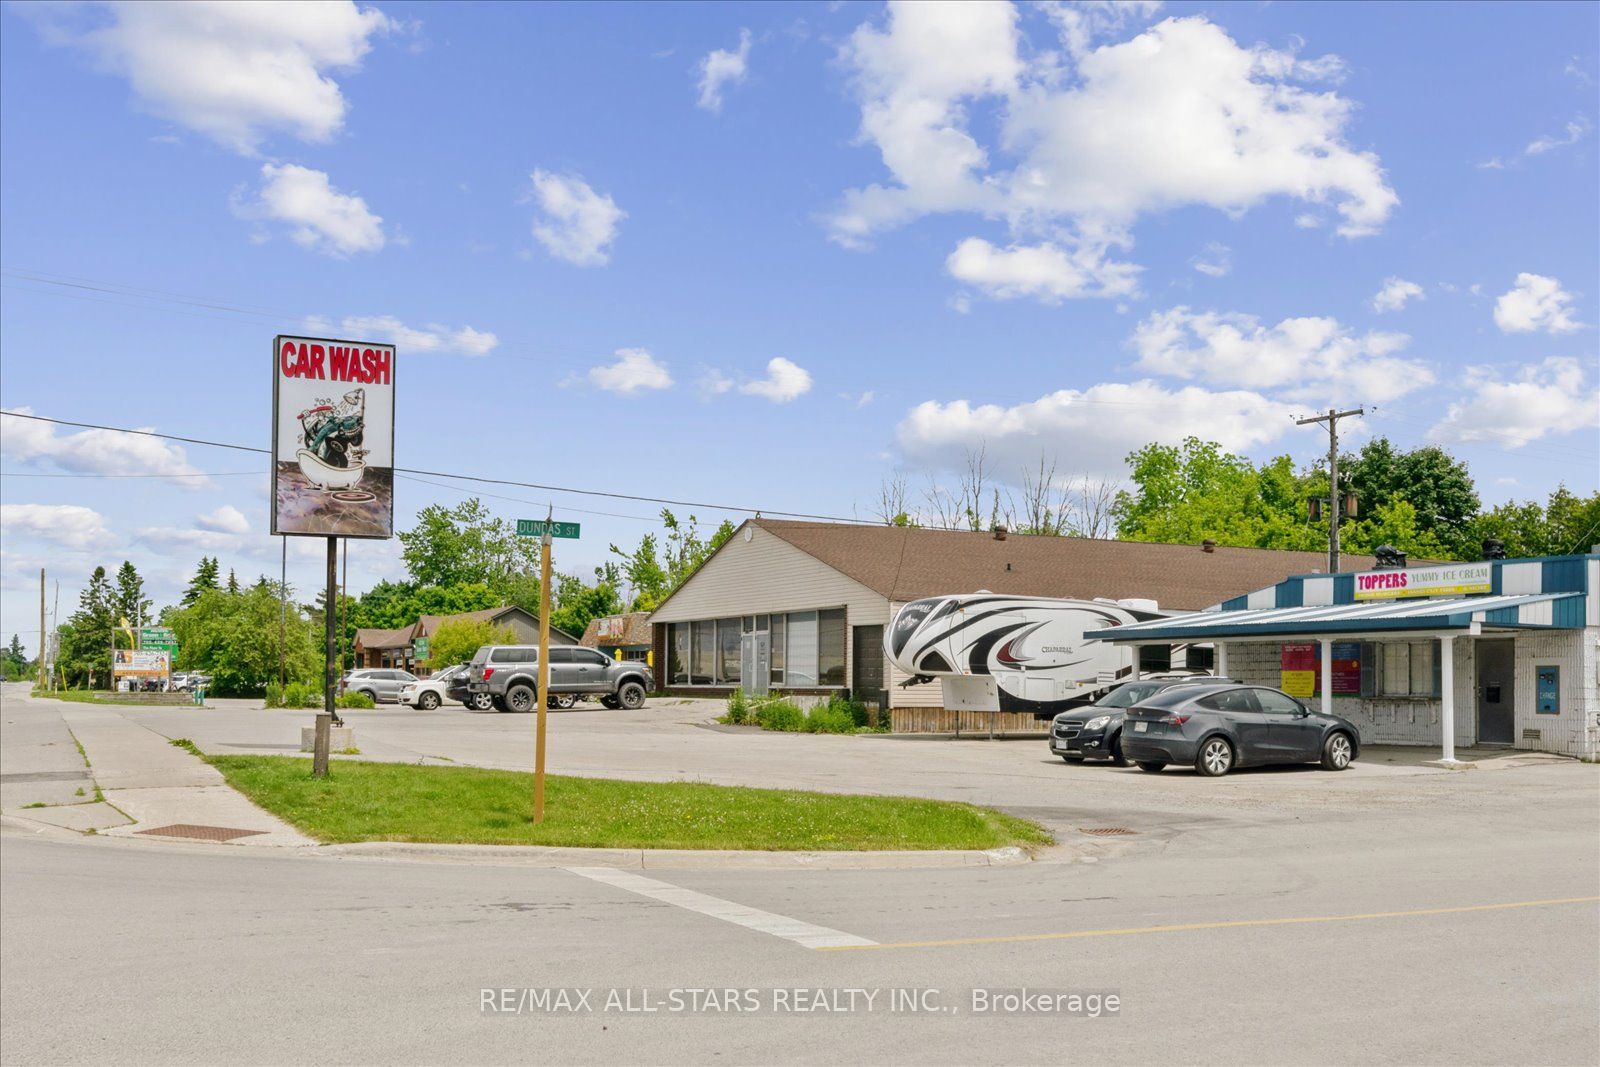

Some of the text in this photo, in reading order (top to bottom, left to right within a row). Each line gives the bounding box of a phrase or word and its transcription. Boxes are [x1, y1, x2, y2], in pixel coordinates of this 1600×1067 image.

[281, 341, 391, 385] CAR WASH
[519, 521, 575, 536] DUNDAS ST
[1358, 568, 1488, 590] TOPPERS YUMMY ICE CREAM
